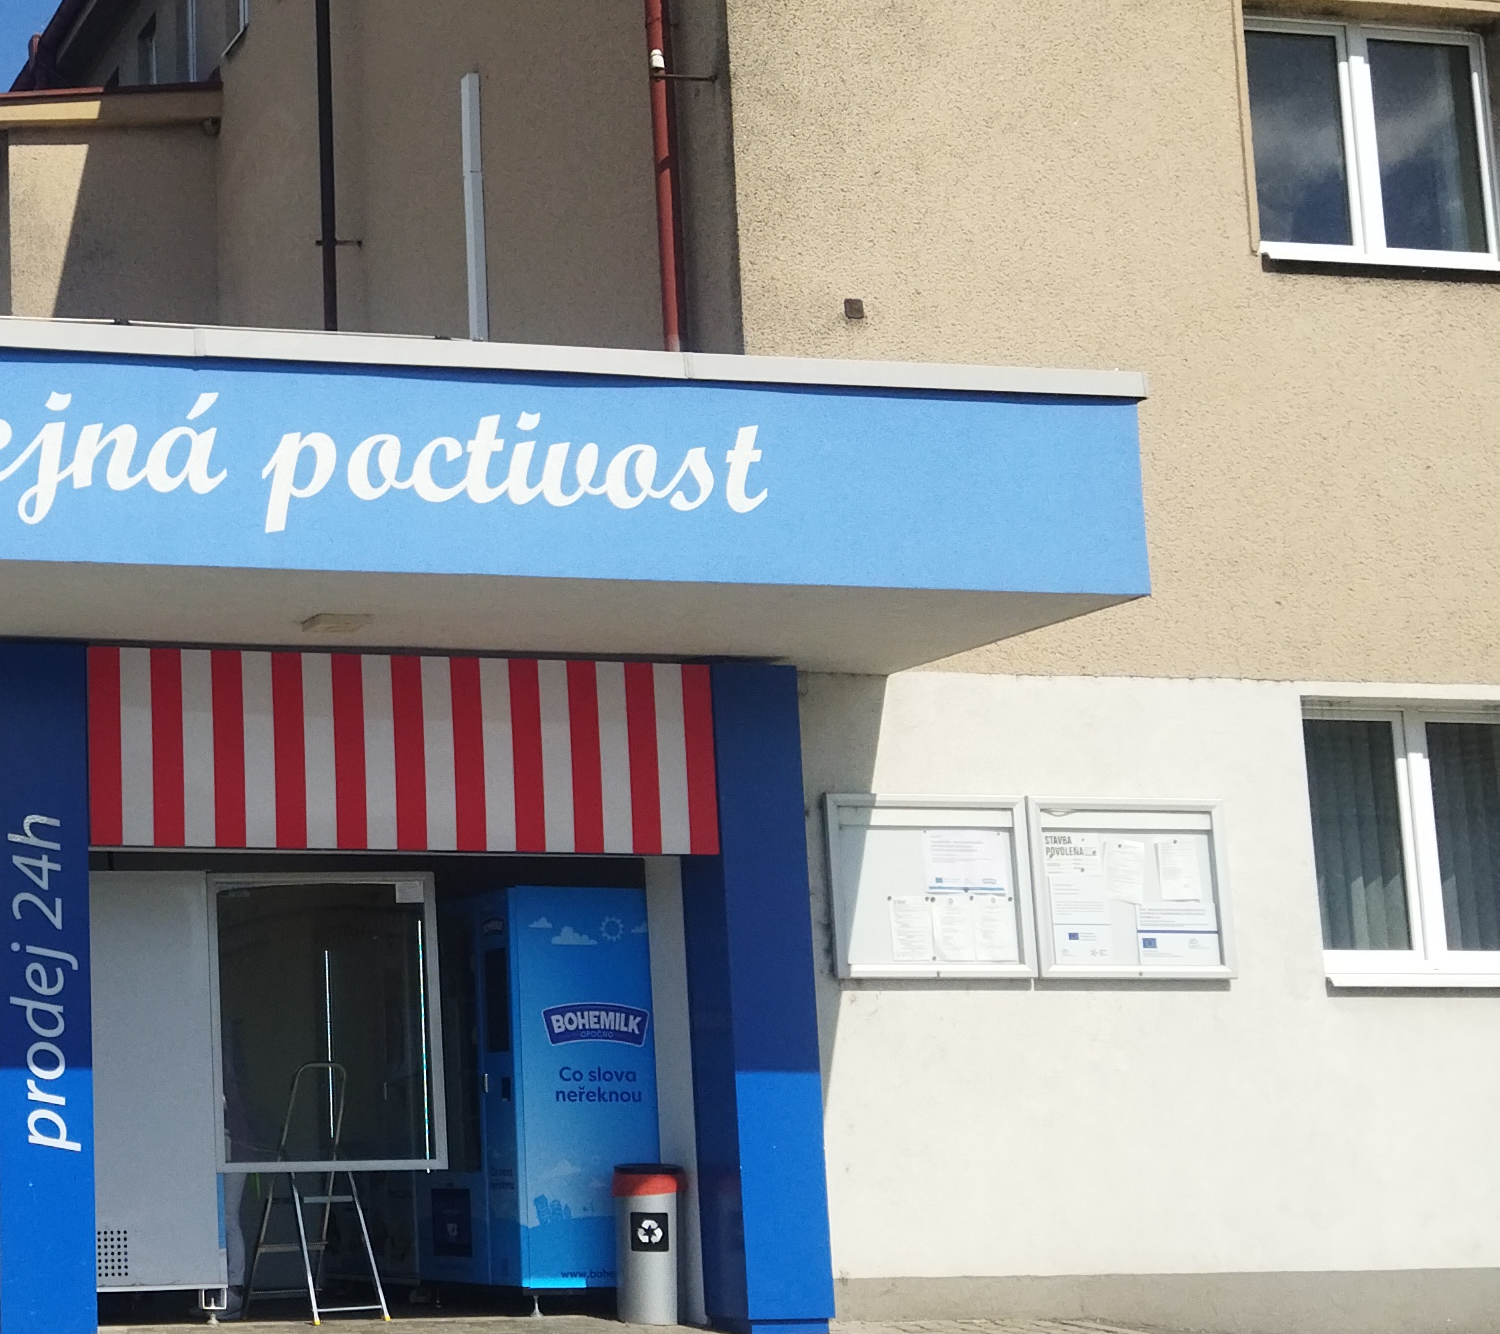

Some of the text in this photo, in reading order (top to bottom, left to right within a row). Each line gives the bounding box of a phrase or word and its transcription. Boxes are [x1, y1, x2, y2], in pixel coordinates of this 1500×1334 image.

[260, 413, 770, 534] poctivost
[1044, 835, 1073, 845] STAVBA
[6, 813, 83, 1153] prodej 24h
[550, 1010, 642, 1035] BOHEMILK
[559, 1066, 637, 1083] Co slova
[555, 1085, 643, 1103] neřeknou
